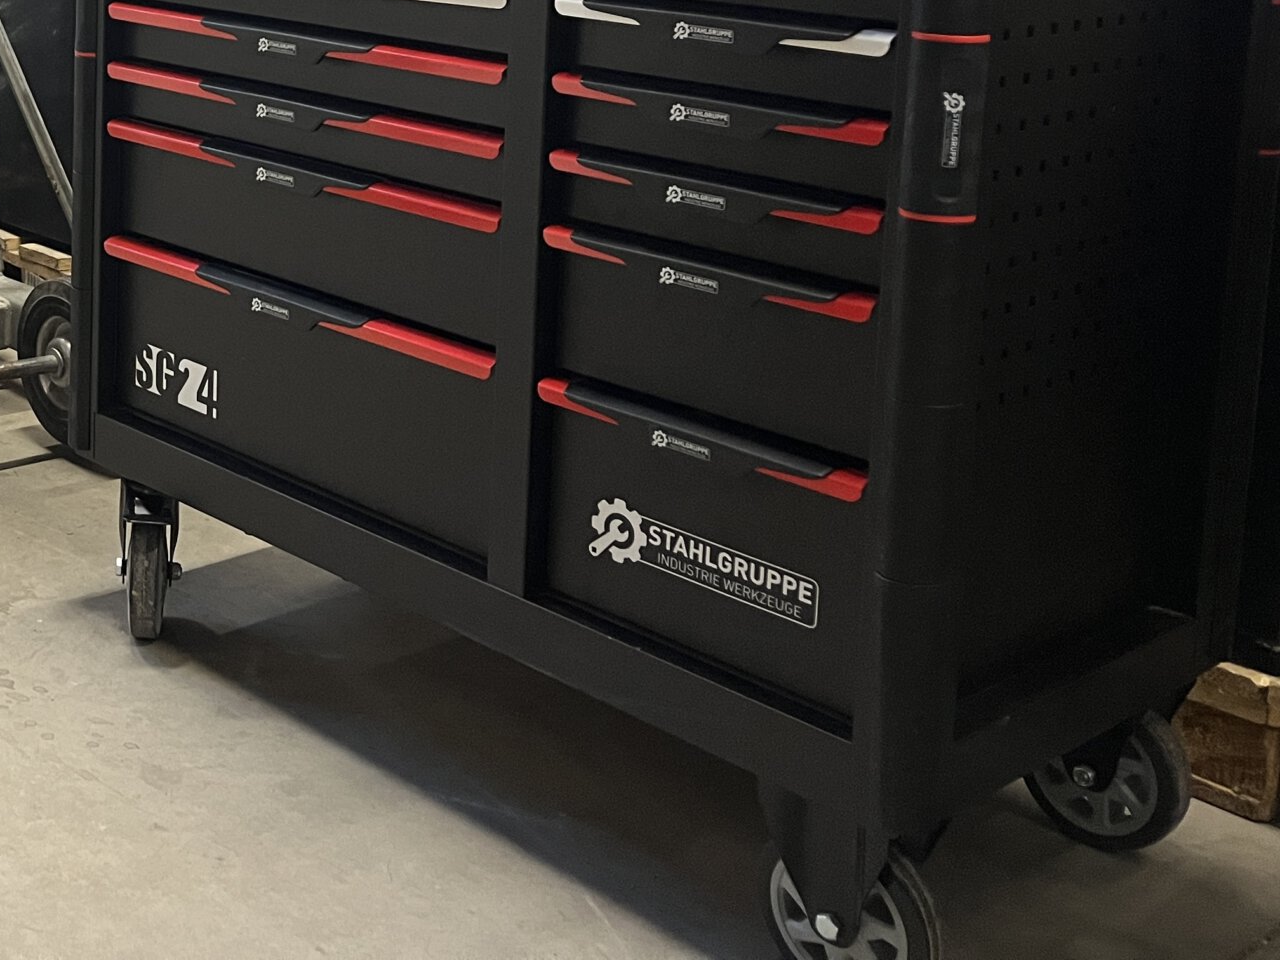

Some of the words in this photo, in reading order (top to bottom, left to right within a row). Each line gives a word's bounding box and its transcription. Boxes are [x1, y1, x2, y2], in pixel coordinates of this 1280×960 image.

[949, 113, 960, 167] STAHLGRUPPE
[648, 525, 814, 605] STAHLGRUPPE
[657, 552, 720, 588] INDUSTRIE
[723, 577, 803, 618] WERKZEUGE
